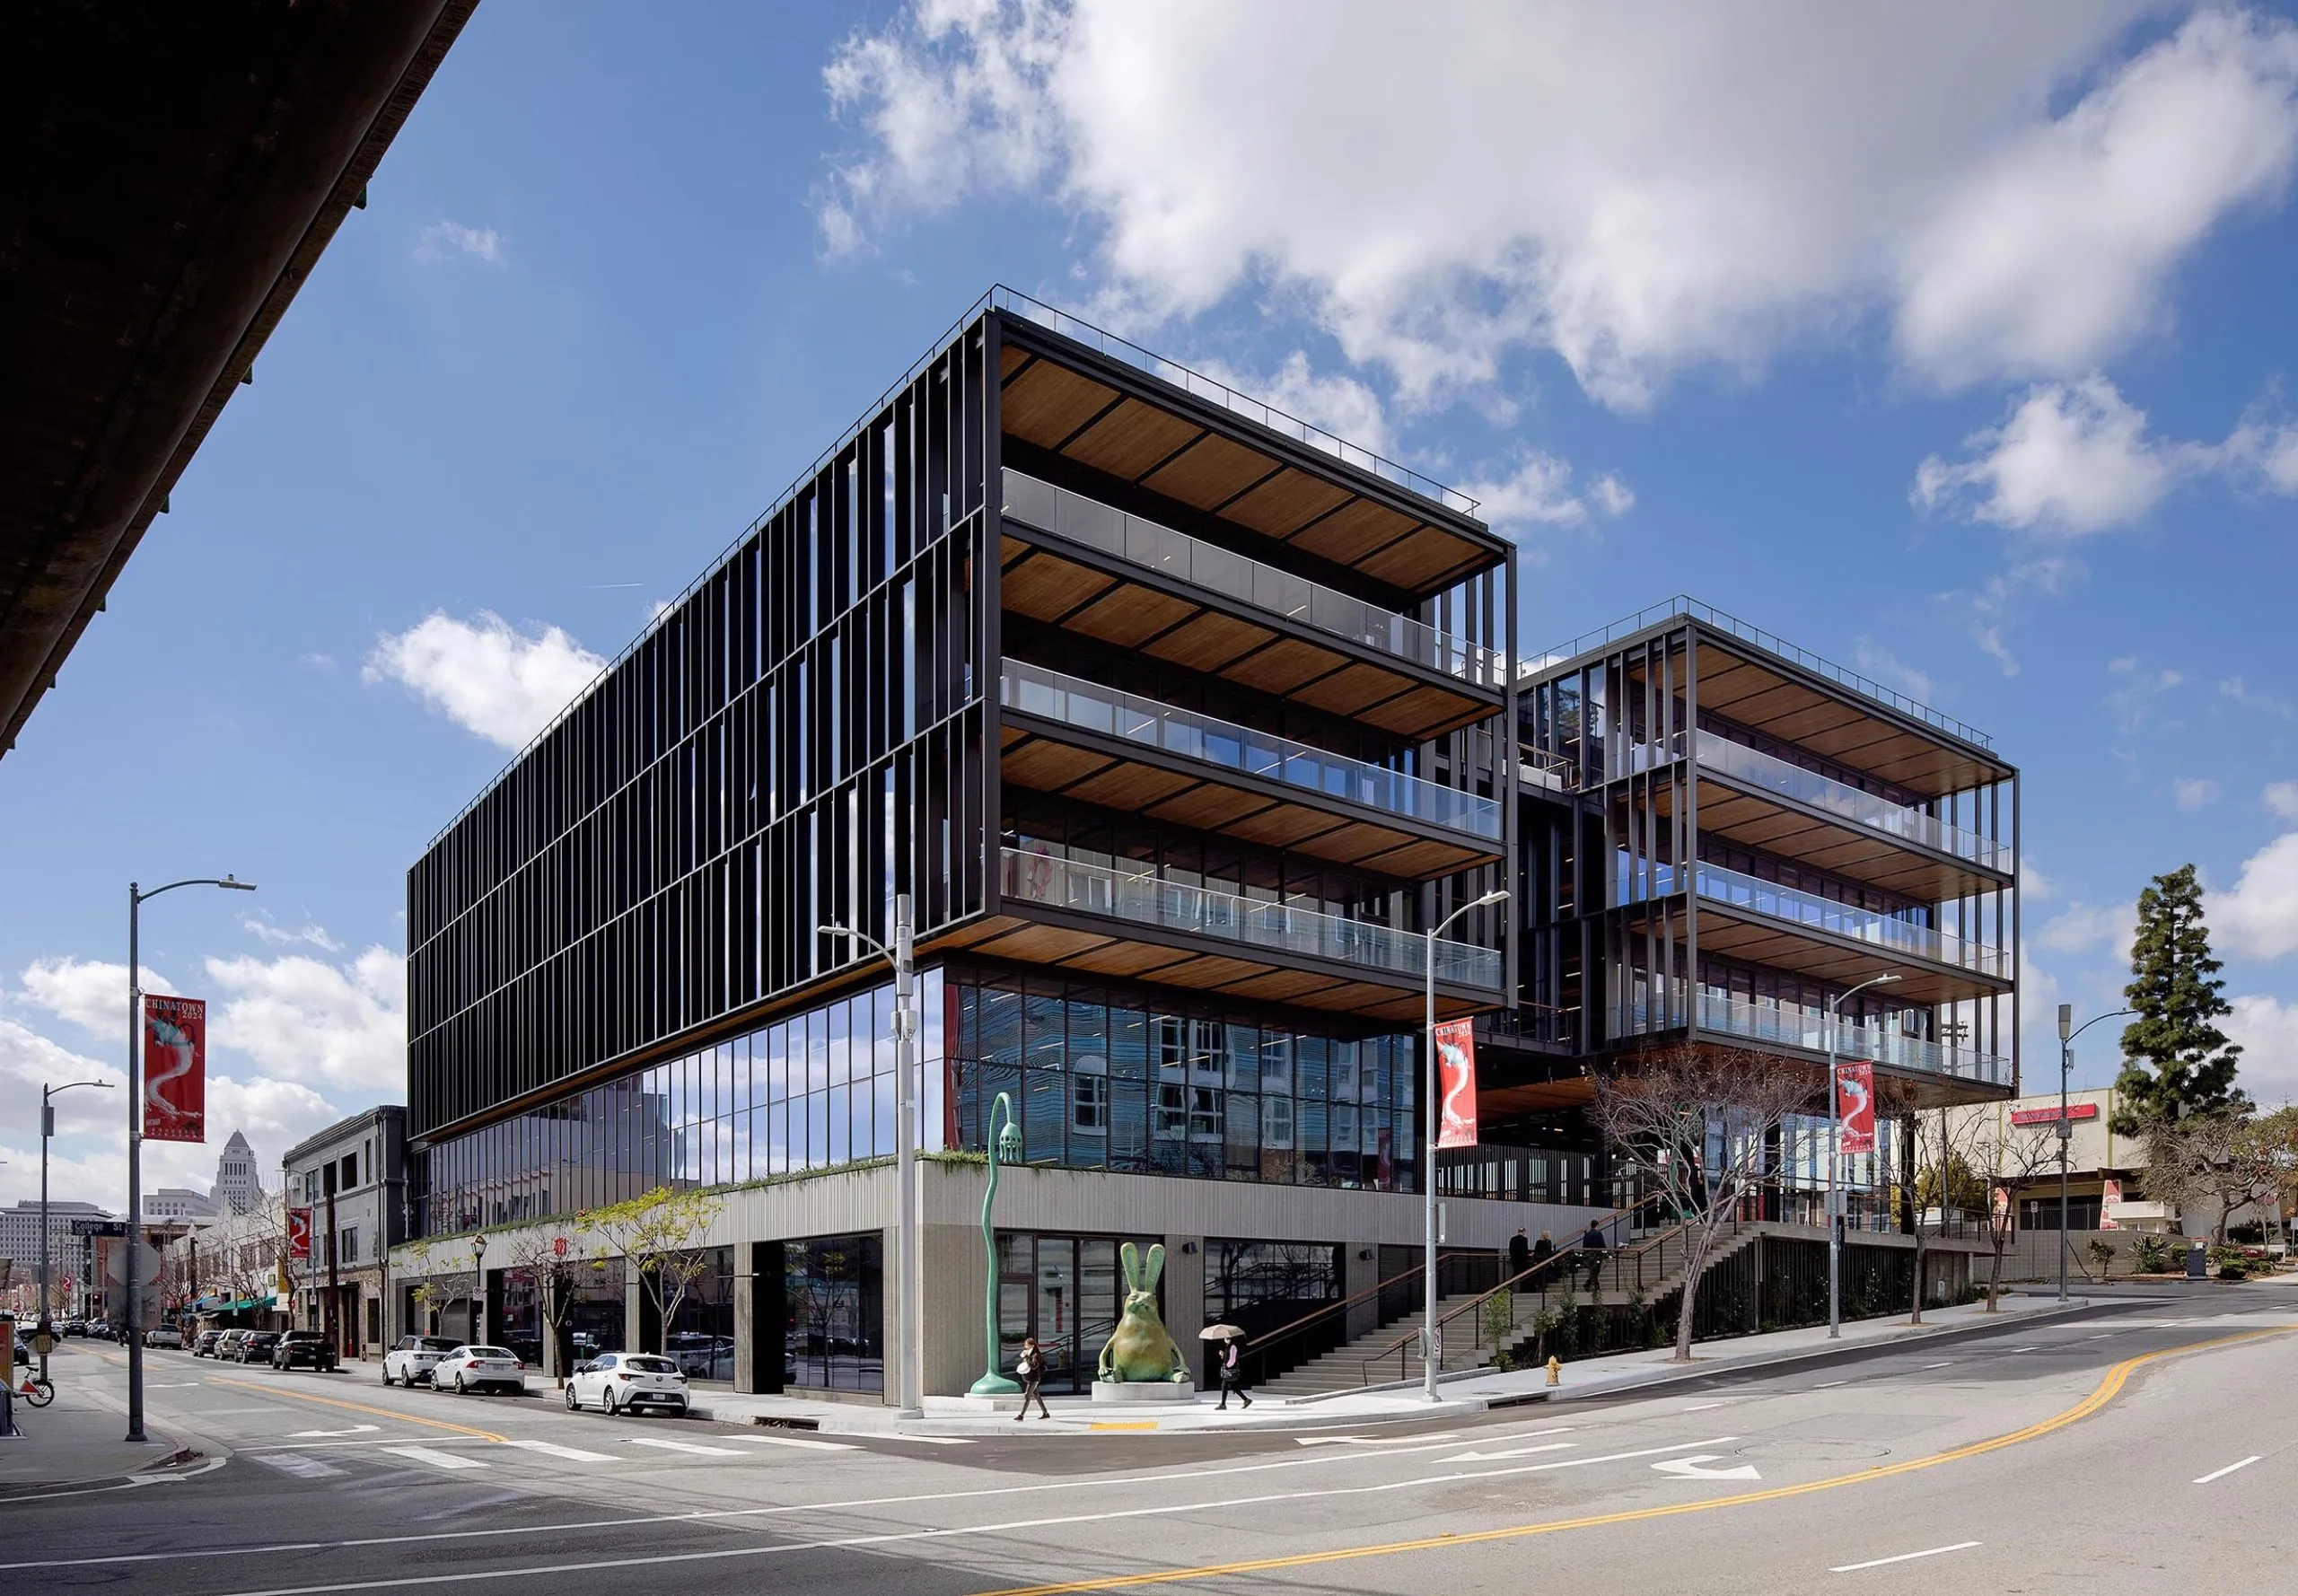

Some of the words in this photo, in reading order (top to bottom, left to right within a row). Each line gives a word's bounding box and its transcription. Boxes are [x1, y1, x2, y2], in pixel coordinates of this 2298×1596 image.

[145, 998, 204, 1013] CHINATOWN
[182, 1011, 203, 1020] 2024
[1435, 1022, 1471, 1036] CHINATOWN
[1838, 1064, 1872, 1074] CHINATOWN
[75, 1222, 104, 1232] College
[113, 1223, 123, 1231] St
